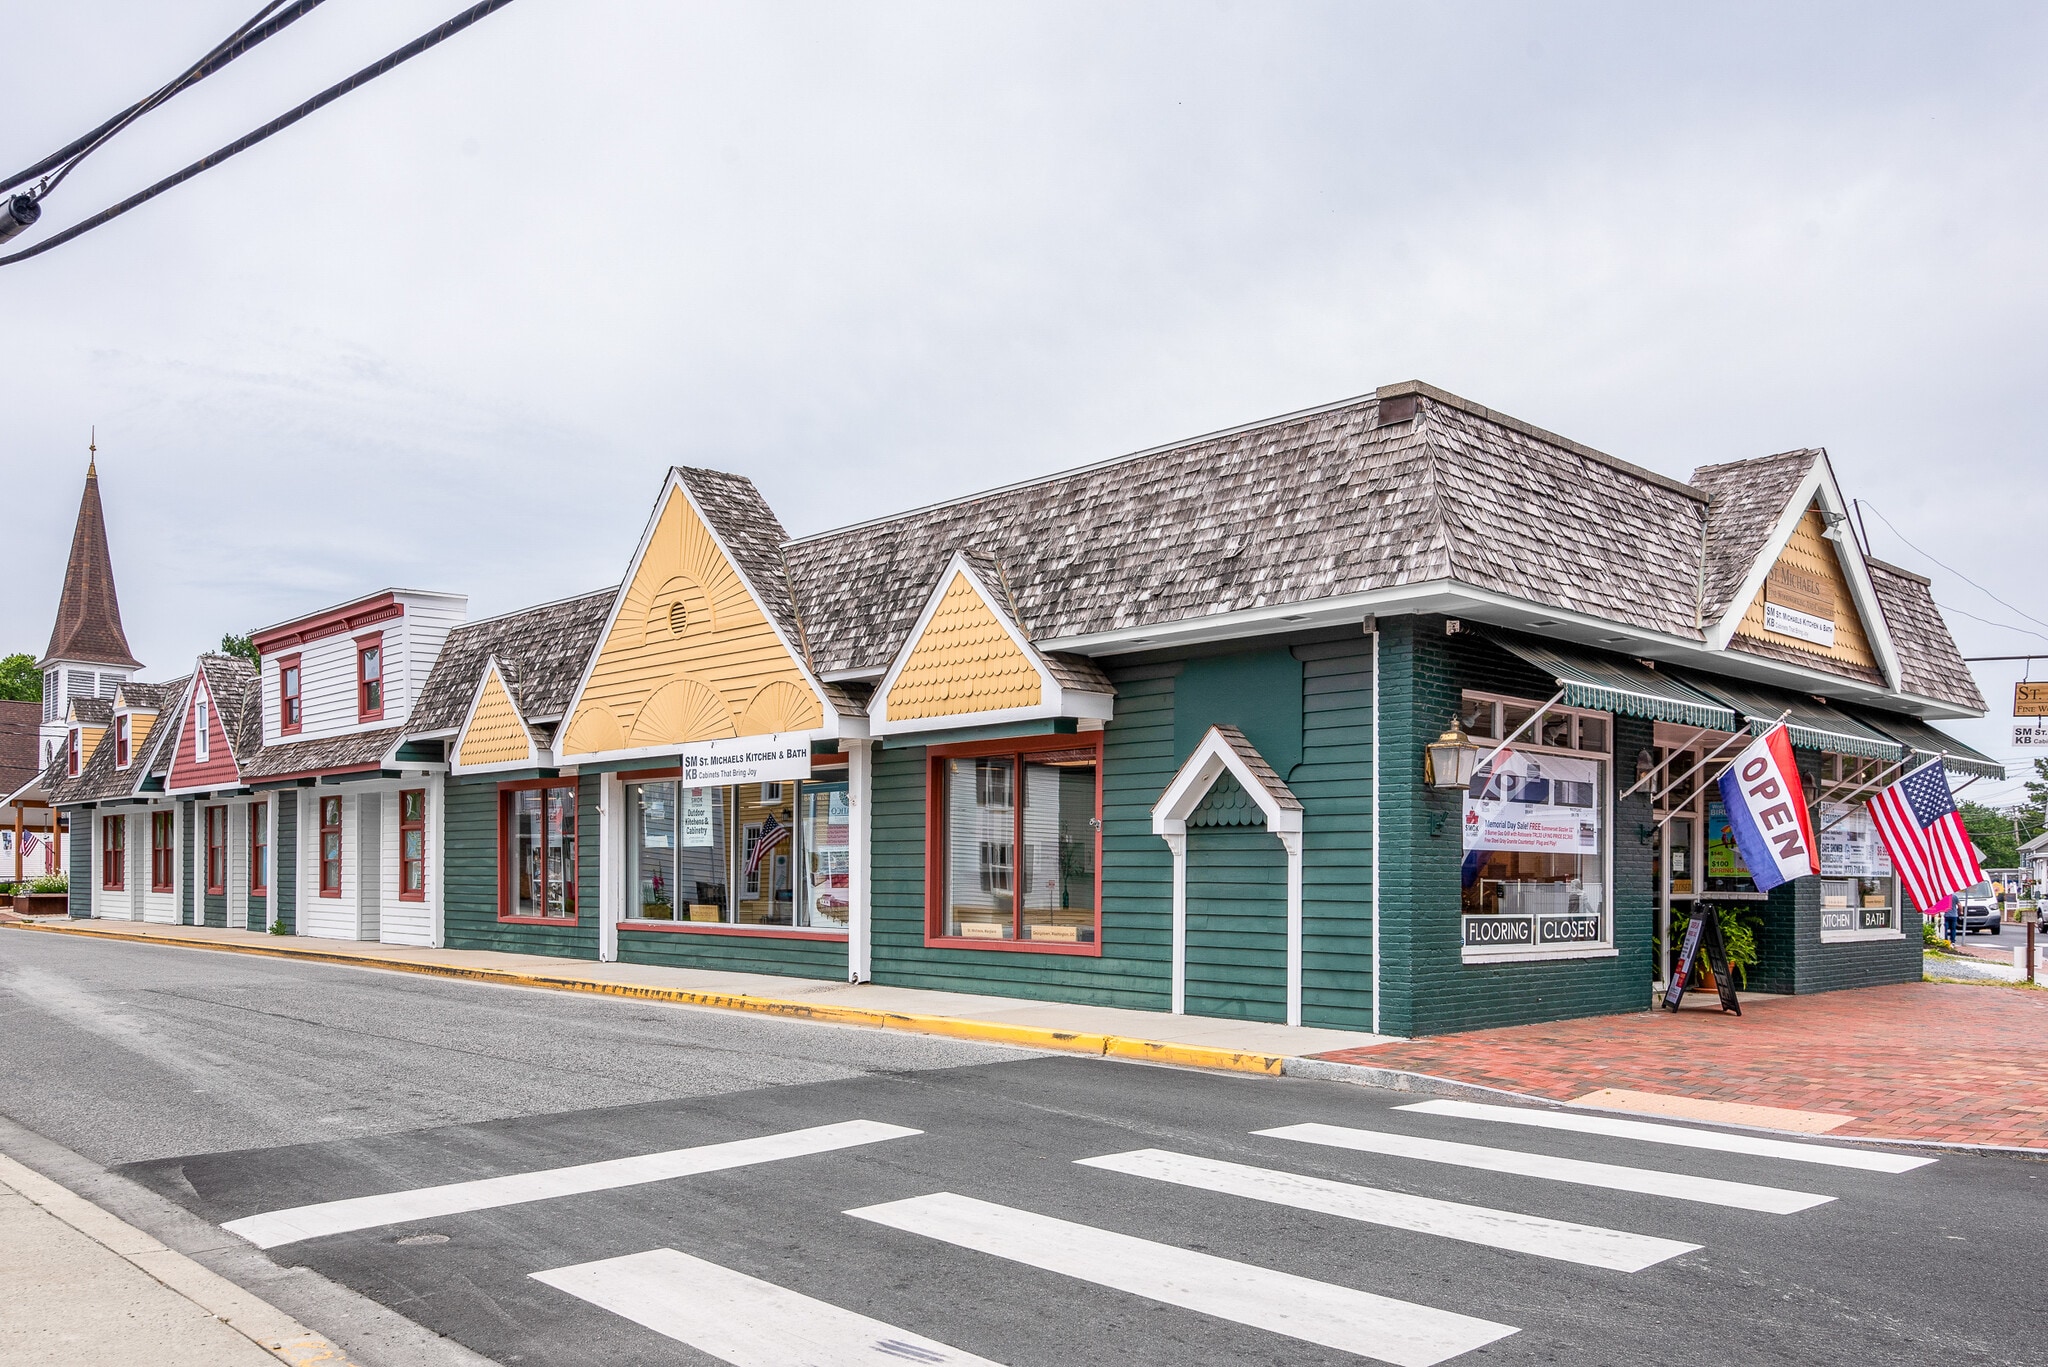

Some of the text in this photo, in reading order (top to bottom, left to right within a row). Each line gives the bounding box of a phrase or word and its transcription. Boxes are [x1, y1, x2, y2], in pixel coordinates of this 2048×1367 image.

[1781, 567, 1820, 596] MICHAELS
[1766, 606, 1775, 617] SM
[1782, 612, 1802, 625] MICHAELS
[1803, 618, 1818, 630] KITCHEN
[1823, 624, 1833, 633] BATH
[1766, 617, 1775, 627] KB
[2018, 686, 2042, 700] ST.
[685, 748, 807, 768] SM ST. MICHAELS KITCHEN & BATH
[685, 769, 698, 780] KB
[699, 771, 719, 779] Cabinets
[732, 769, 746, 778] Bring
[747, 768, 757, 776] Joy
[1742, 757, 1805, 860] OPEN
[686, 827, 707, 835] Cabinetry
[1485, 820, 1507, 828] Memorial
[1507, 821, 1516, 830] Day
[1517, 822, 1528, 830] Sale!
[1822, 914, 1850, 928] KITCHEN
[1865, 913, 1885, 926] BATH
[1469, 922, 1528, 941] FLOORING
[1544, 920, 1596, 939] CLOSETS
